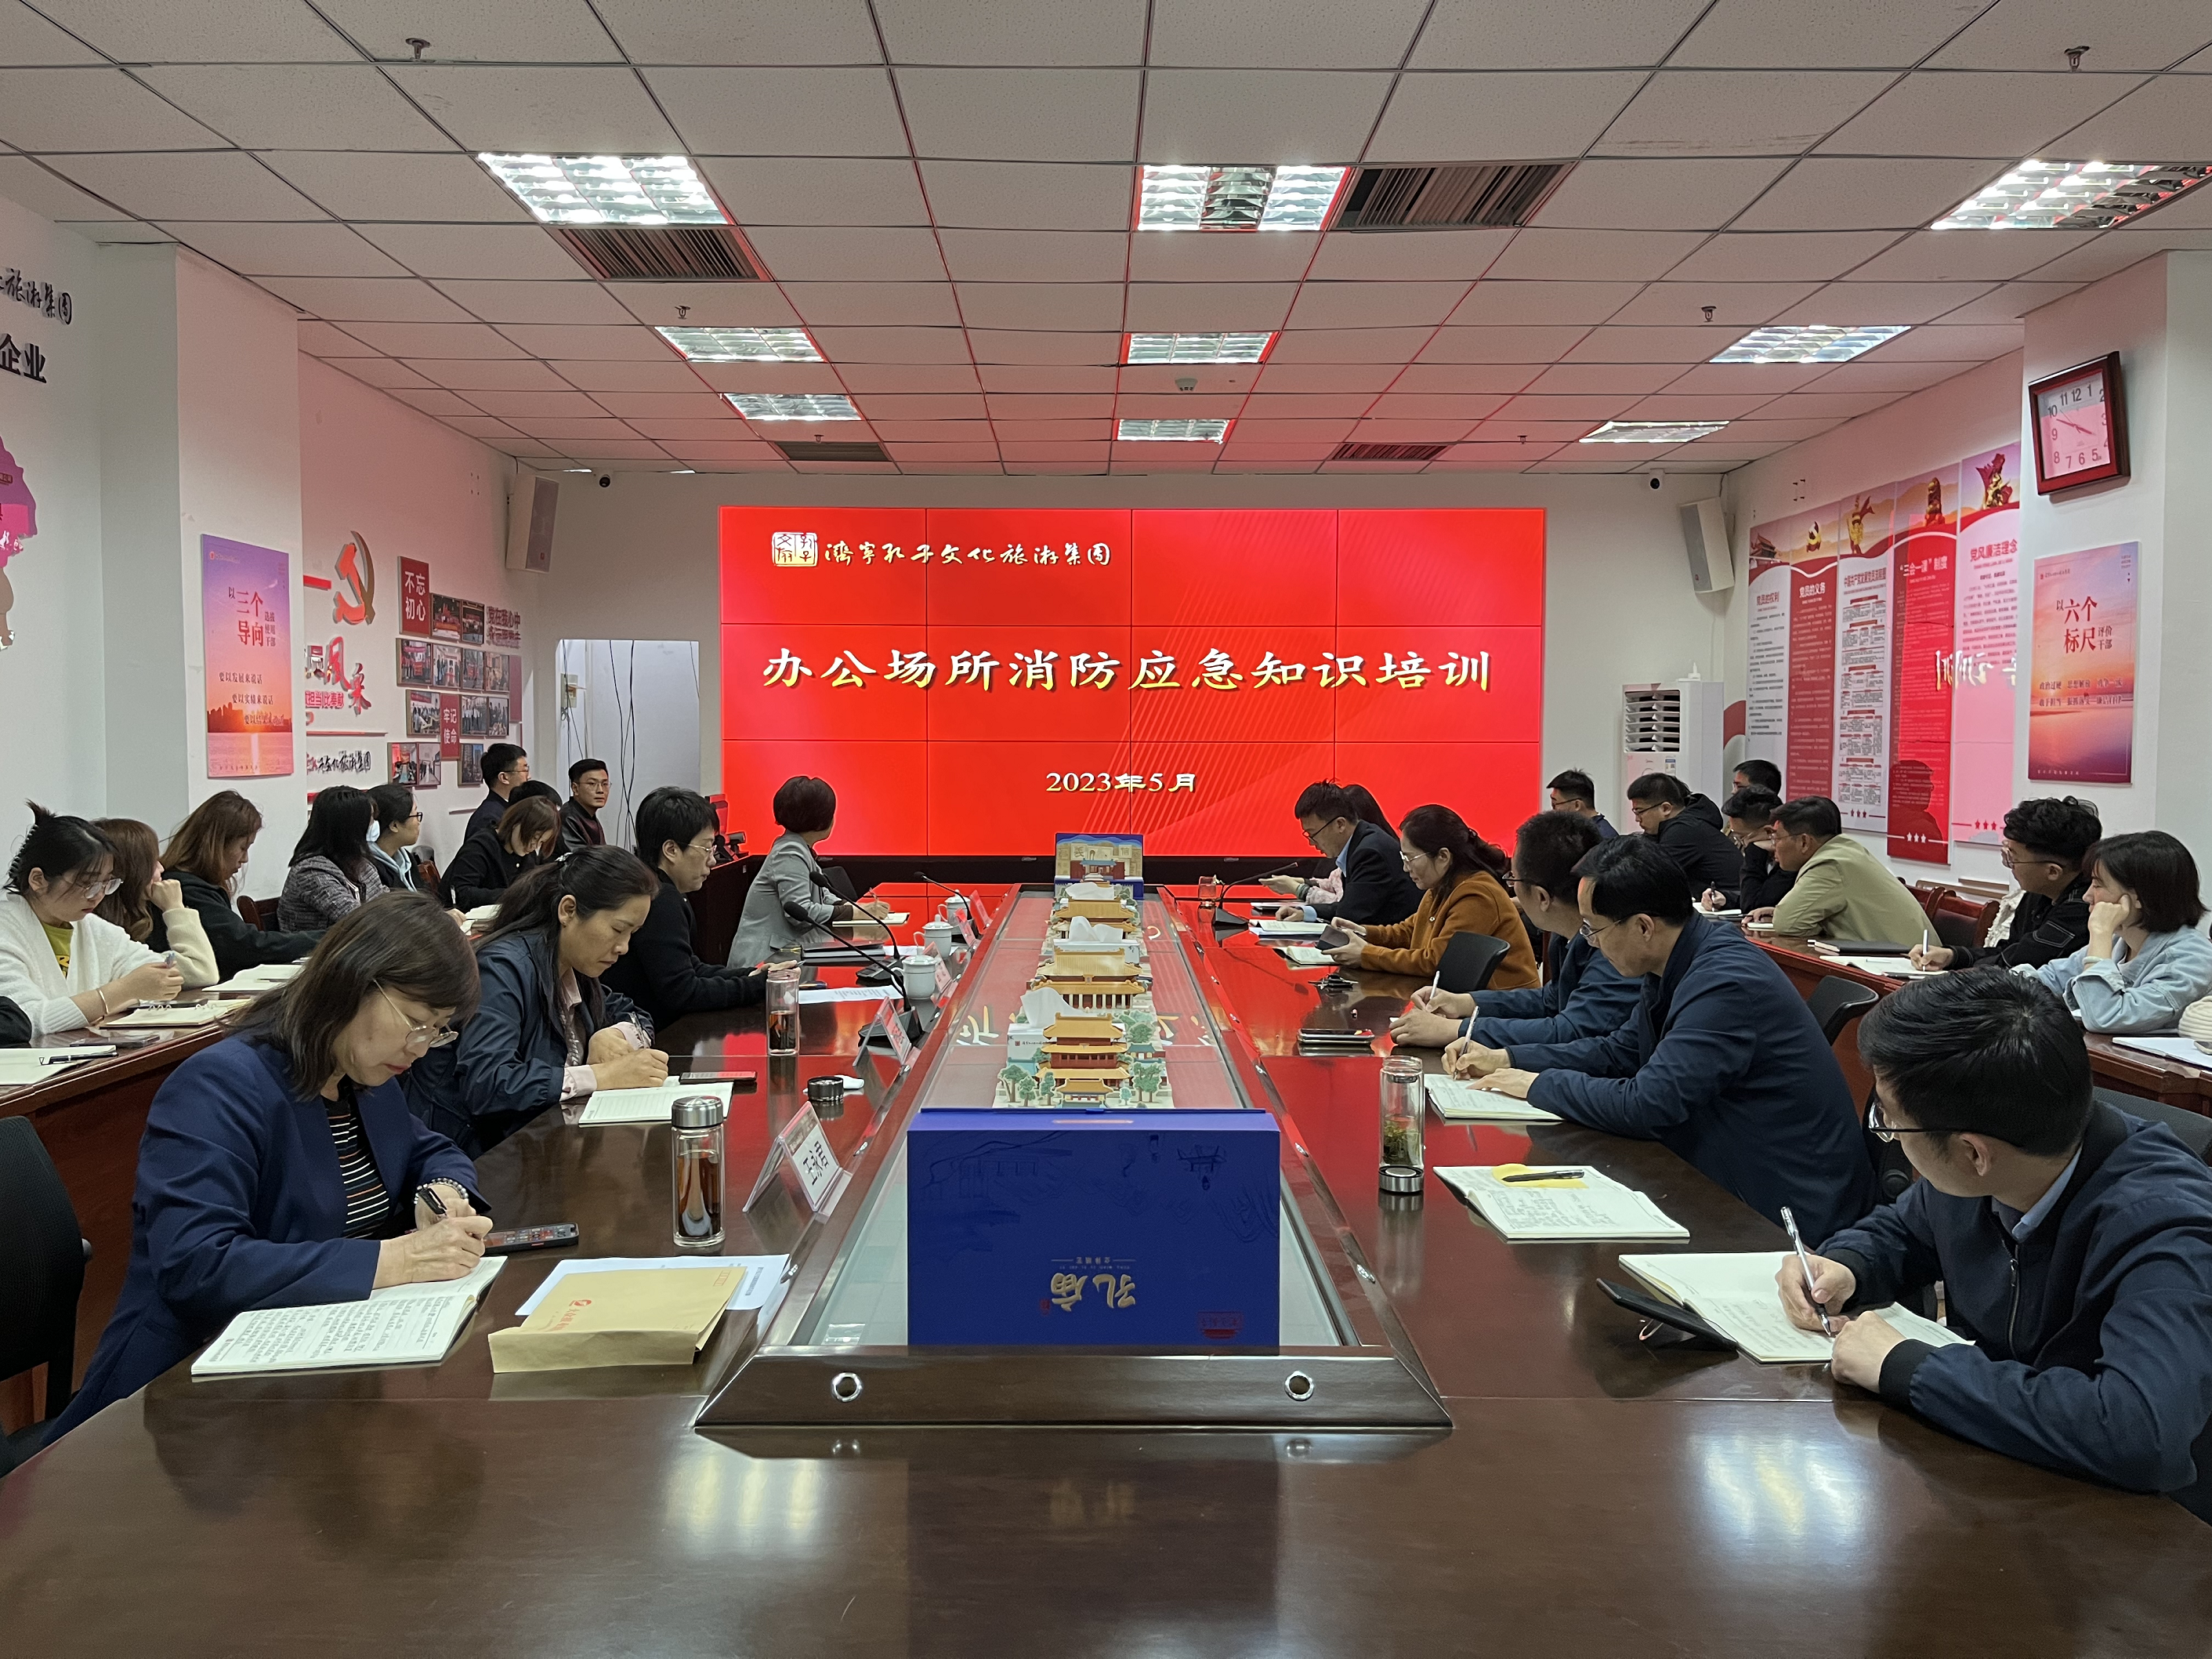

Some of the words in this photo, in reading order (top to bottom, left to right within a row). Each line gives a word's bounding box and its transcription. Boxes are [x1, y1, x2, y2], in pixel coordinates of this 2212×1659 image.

[0, 267, 72, 325] 旅游集团
[0, 333, 47, 383] 企业
[2060, 392, 2068, 407] 11
[2072, 388, 2082, 403] 12
[2047, 404, 2058, 418] 10
[2051, 429, 2058, 440] 9
[2054, 451, 2060, 464] 8
[2065, 456, 2073, 469] 7
[2078, 452, 2085, 465] 6
[404, 571, 426, 596] 不忘
[404, 596, 426, 621] 初心
[237, 620, 264, 647] 导向
[2063, 627, 2097, 654] 标尺
[763, 648, 1490, 691] 办公场所消防应急知识培训
[443, 729, 458, 745] 使命
[1046, 771, 1197, 794] 2023年5月
[1050, 1272, 1136, 1313] 孔庙
